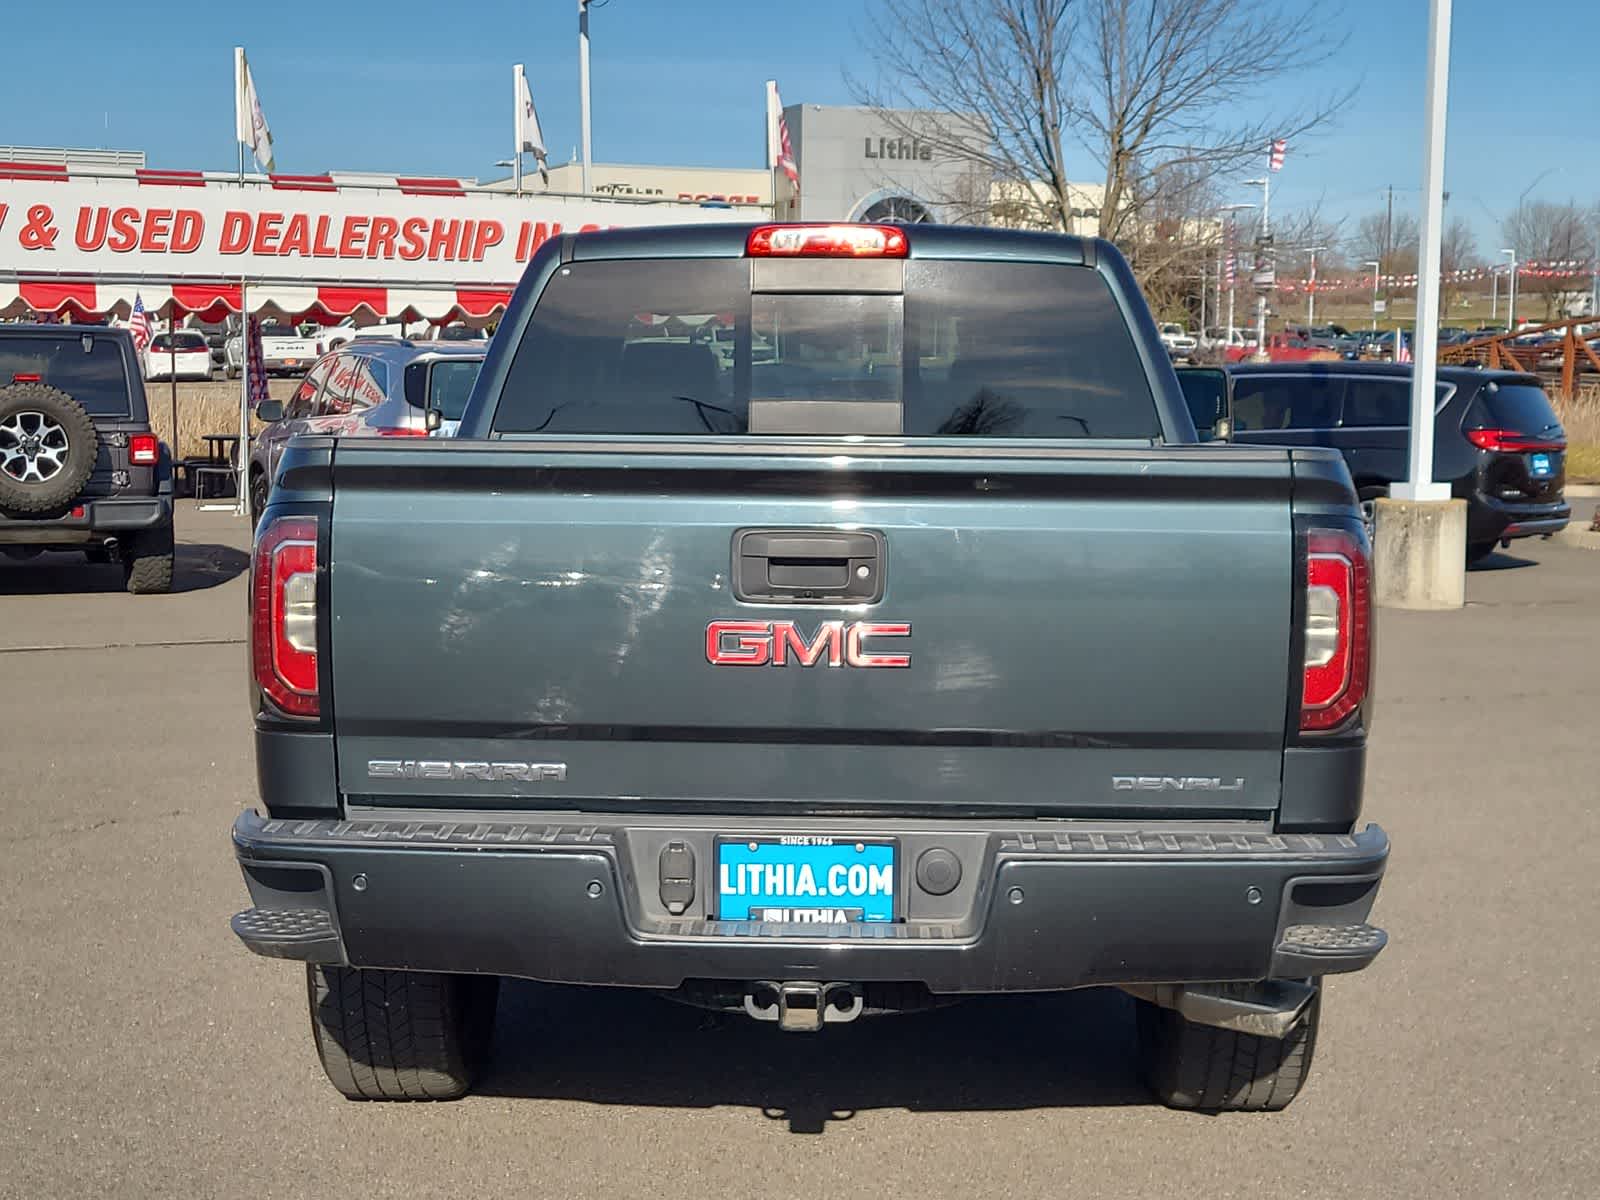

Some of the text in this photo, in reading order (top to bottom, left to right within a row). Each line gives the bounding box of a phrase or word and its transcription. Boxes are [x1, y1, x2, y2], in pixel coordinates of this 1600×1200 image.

[865, 137, 933, 160] Lithia
[589, 184, 664, 196] HYSLER
[18, 203, 59, 250] &
[75, 206, 208, 254] USED
[218, 210, 505, 262] DEALERSHIP
[706, 619, 912, 668] GMC
[367, 759, 568, 782] SIERRA
[1112, 776, 1246, 792] DENALI
[780, 835, 809, 846] SINCE
[720, 863, 894, 897] LITHIA.COM
